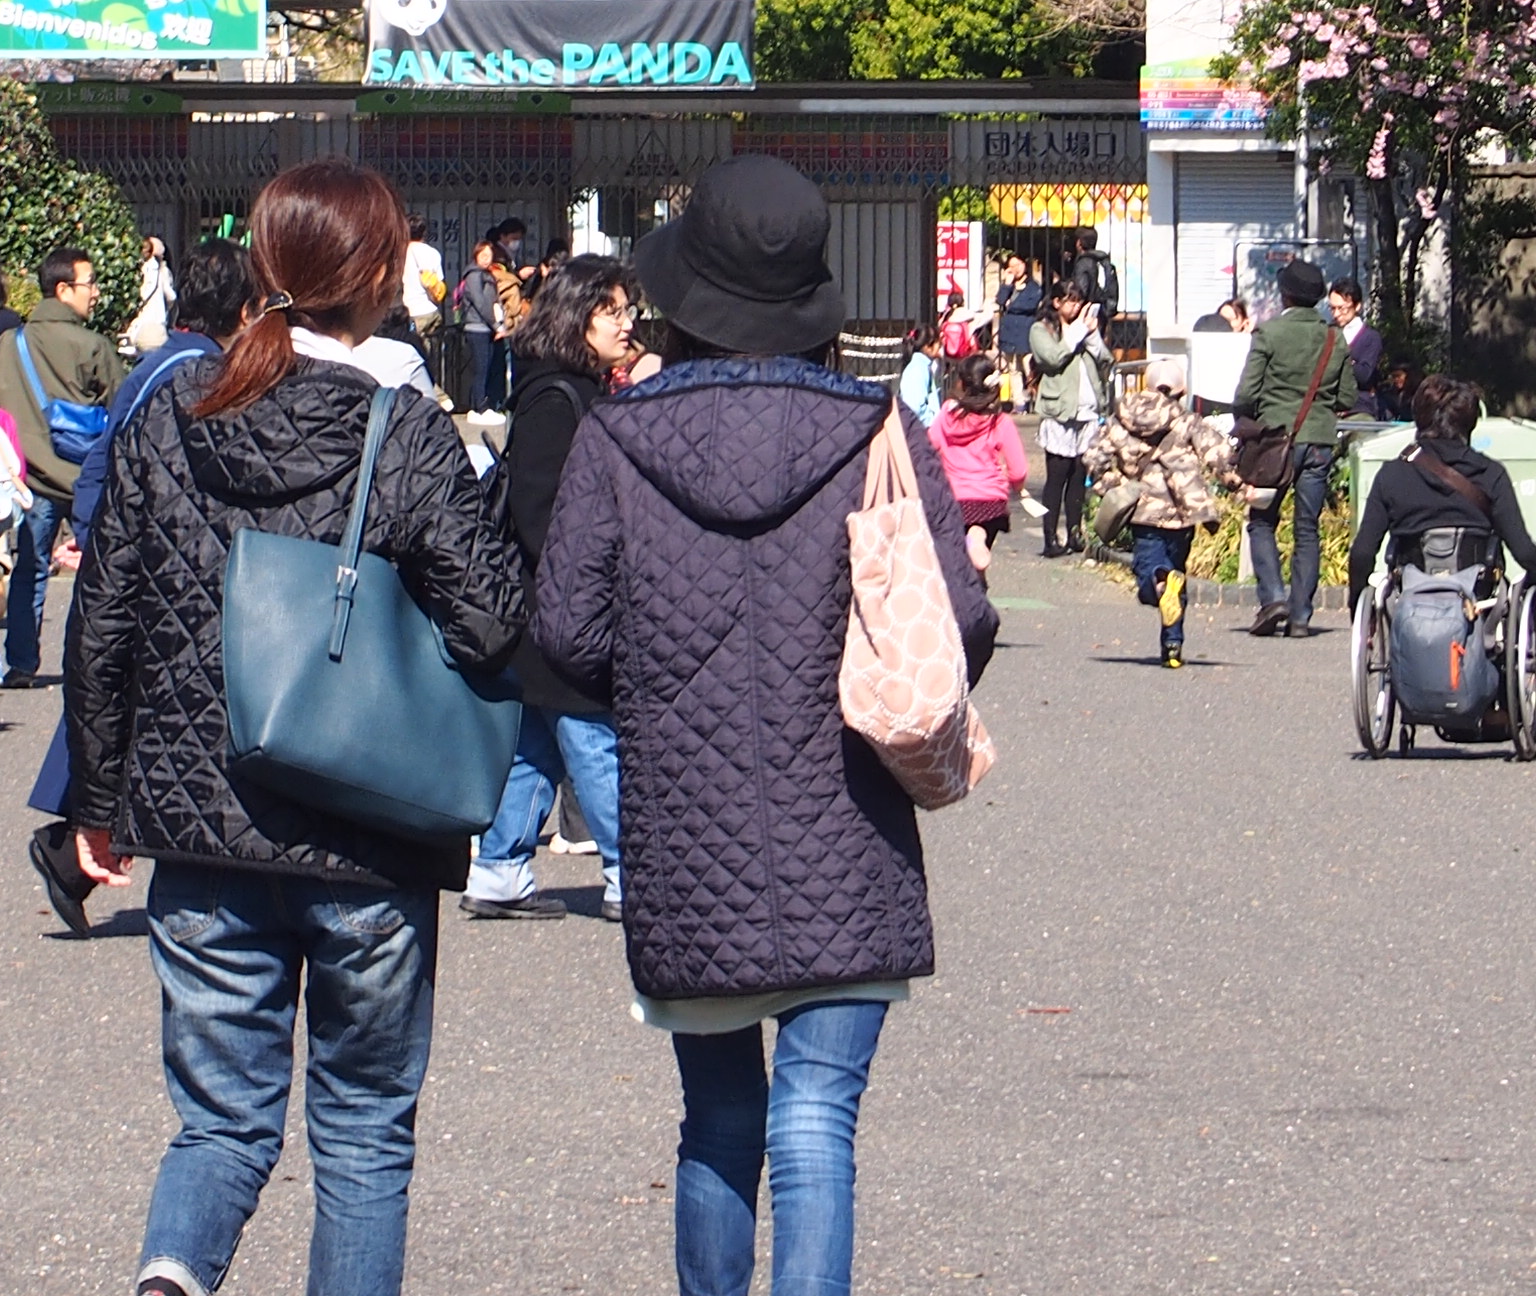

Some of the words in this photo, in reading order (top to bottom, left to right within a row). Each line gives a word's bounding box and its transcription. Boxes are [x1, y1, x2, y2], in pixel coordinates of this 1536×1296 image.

[370, 47, 476, 83] SAVE
[481, 49, 556, 84] the
[563, 41, 753, 85] PANDA
